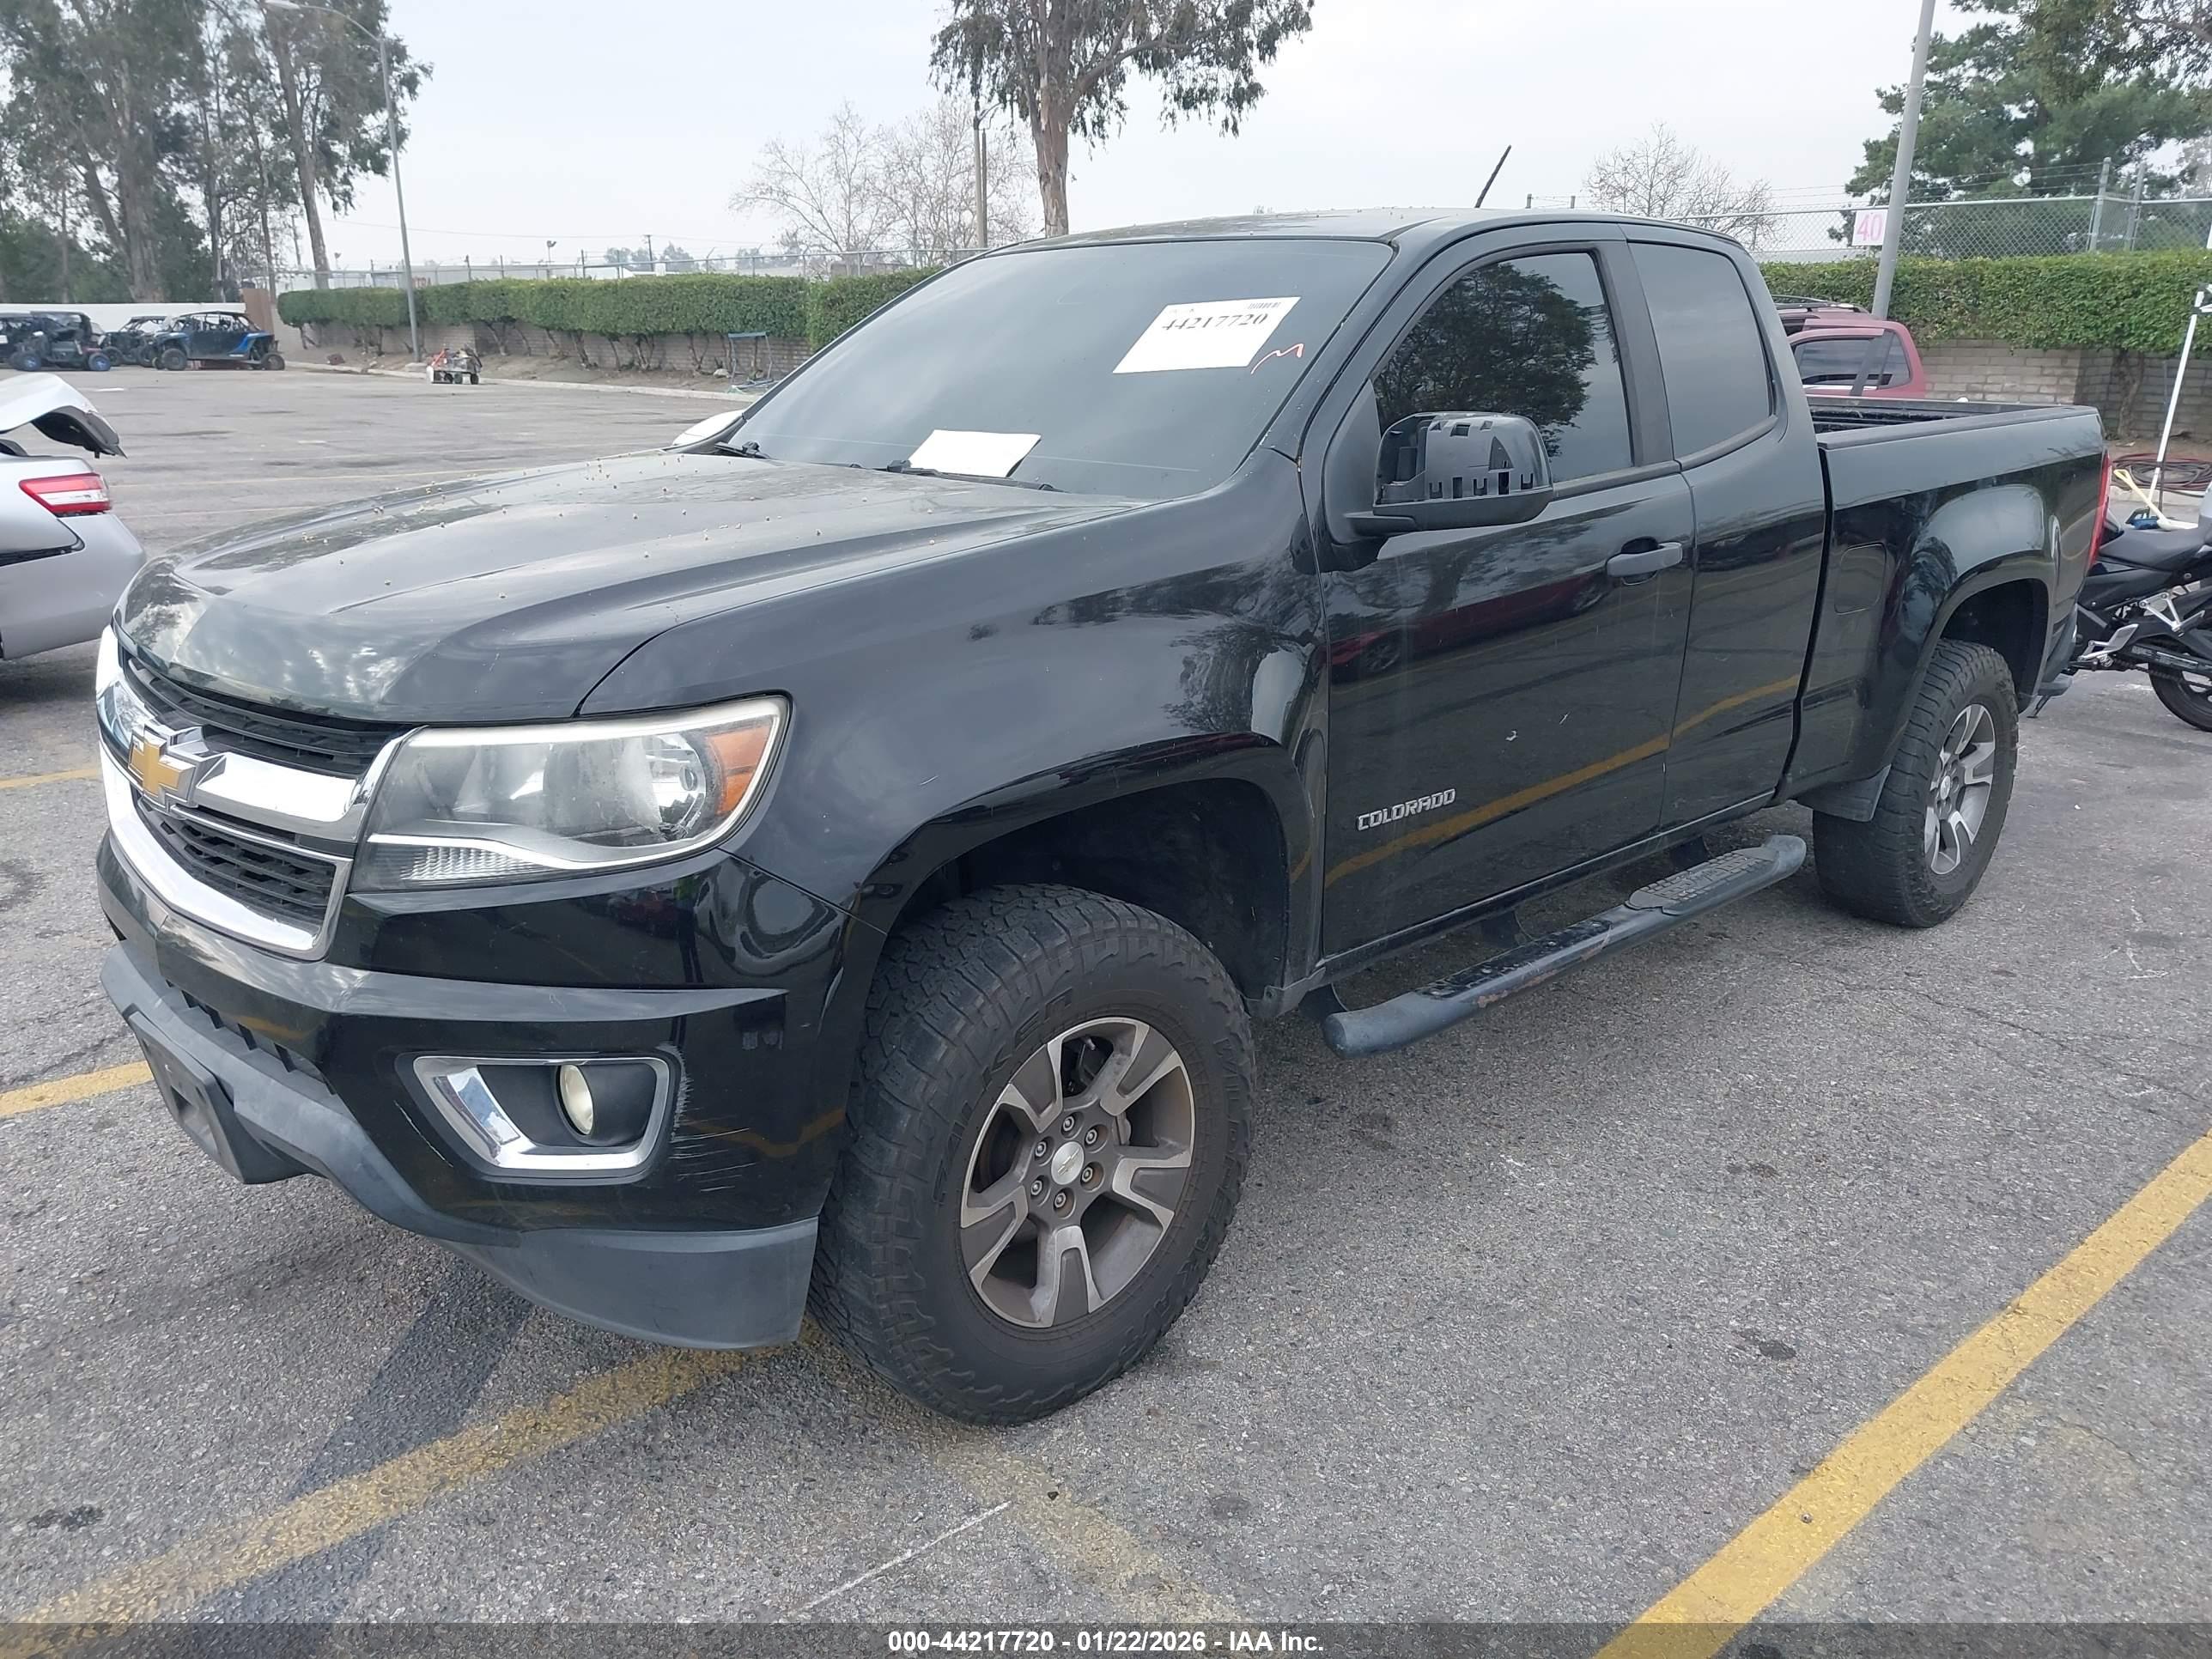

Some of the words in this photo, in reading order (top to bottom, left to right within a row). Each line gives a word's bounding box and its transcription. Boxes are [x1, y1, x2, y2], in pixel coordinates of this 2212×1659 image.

[1856, 213, 1884, 241] 40
[1161, 313, 1268, 331] 44217720
[1358, 788, 1455, 831] COLORADO
